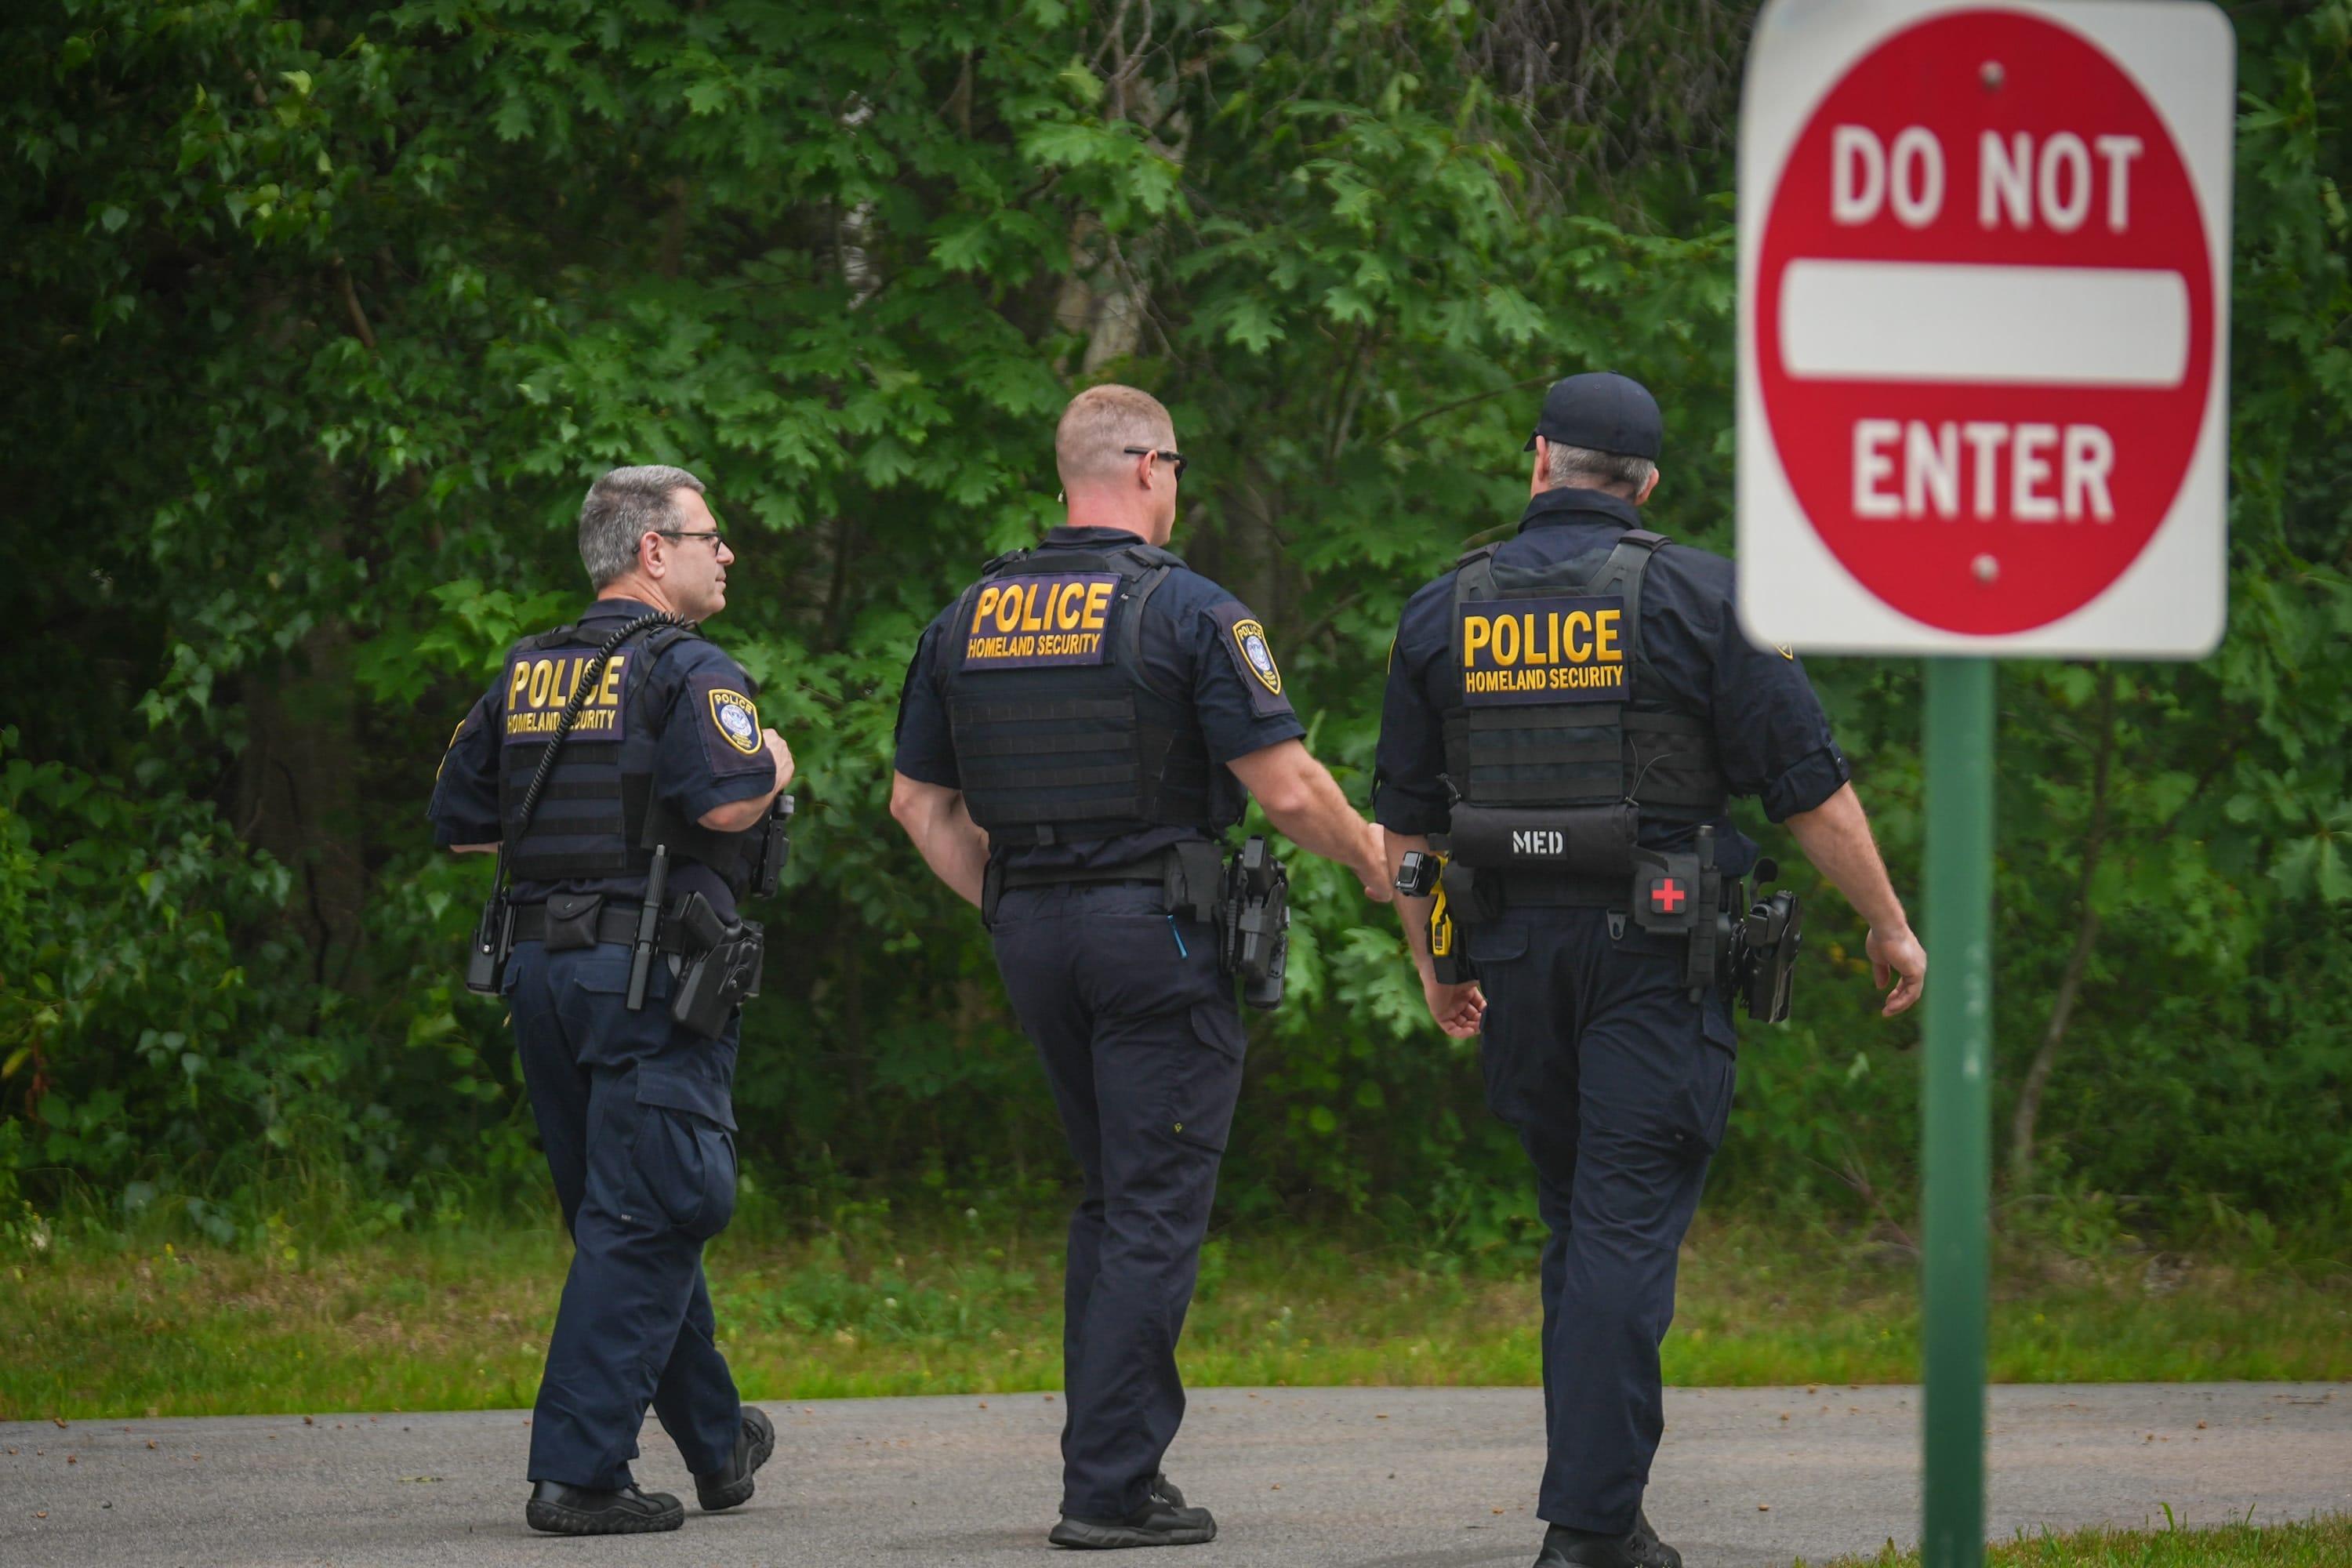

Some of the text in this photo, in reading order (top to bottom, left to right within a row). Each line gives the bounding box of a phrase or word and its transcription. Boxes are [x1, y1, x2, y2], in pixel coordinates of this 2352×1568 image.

[1831, 124, 2143, 233] DO NOT
[1852, 419, 2115, 523] ENTER
[971, 583, 1113, 633] POLICE
[966, 633, 1101, 659] HOMELAND SECURITY
[1238, 625, 1263, 641] POLICE
[1465, 609, 1622, 666] POLICE
[1466, 665, 1623, 693] HOMELAND SECURITY
[714, 694, 753, 714] POLICE
[568, 710, 616, 731] CURITY
[1512, 830, 1563, 854] MED
